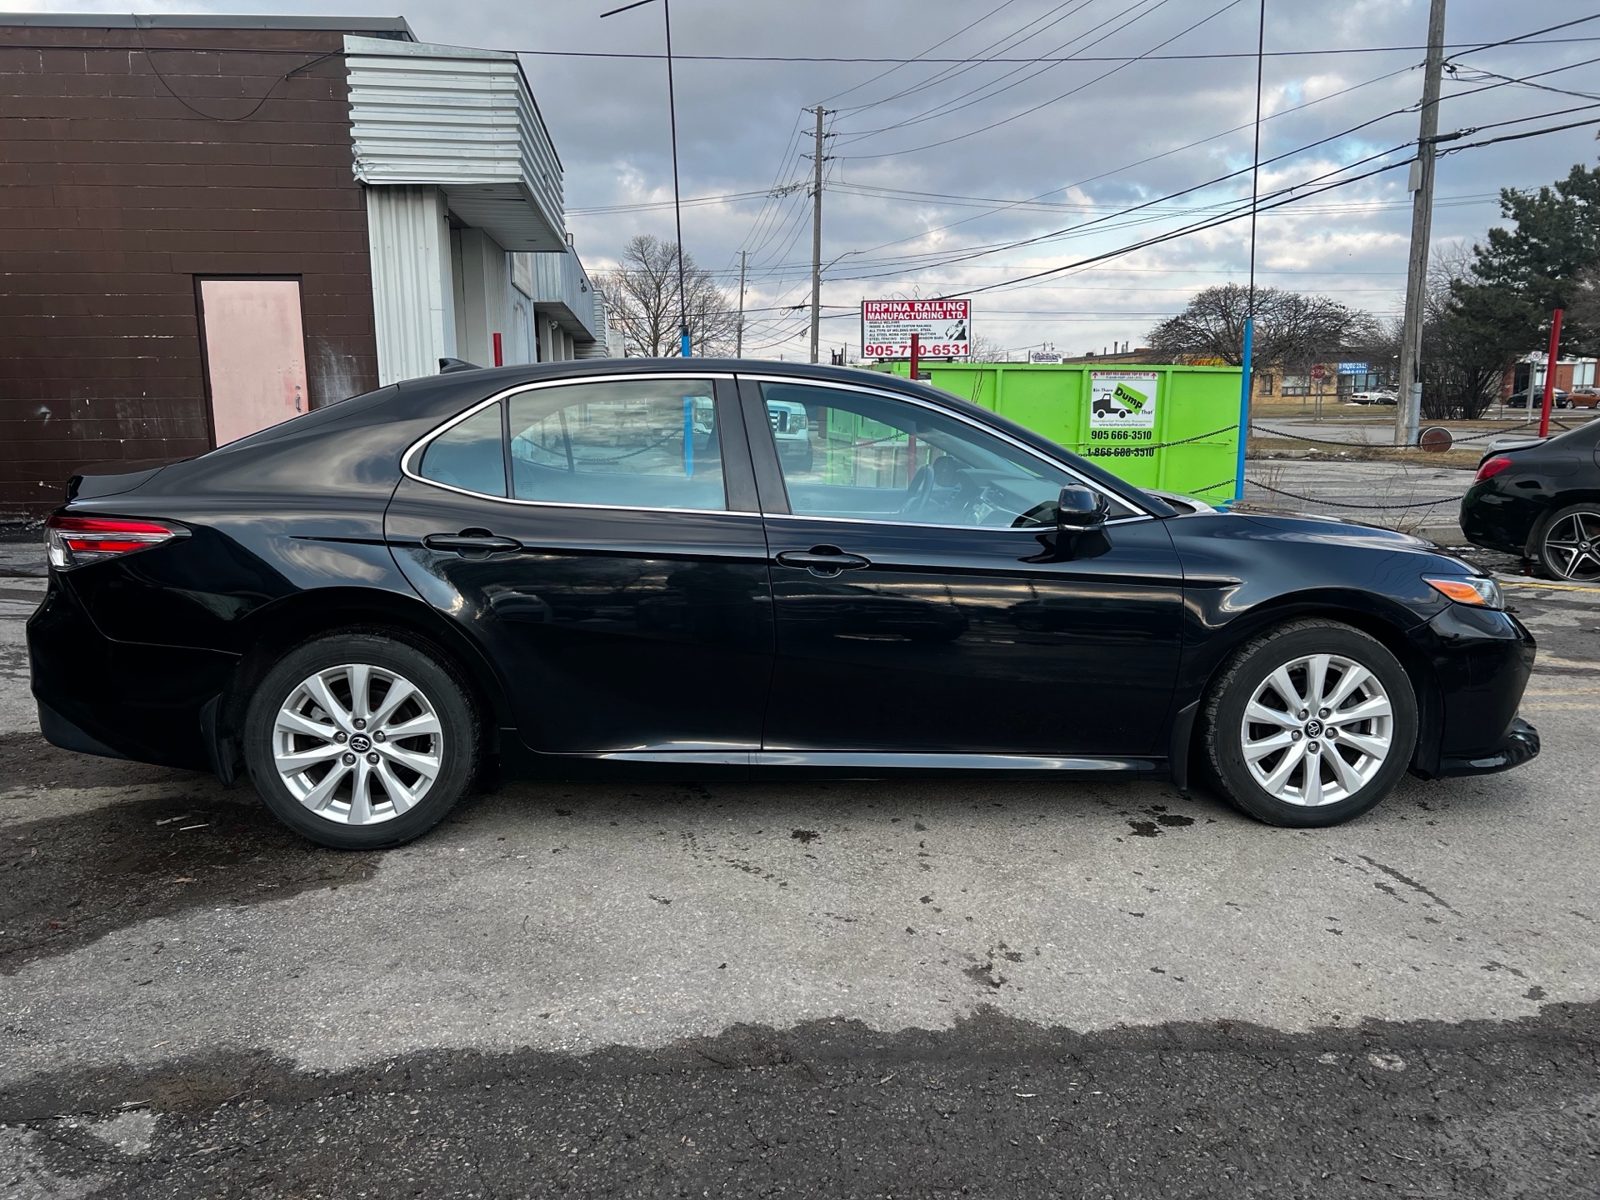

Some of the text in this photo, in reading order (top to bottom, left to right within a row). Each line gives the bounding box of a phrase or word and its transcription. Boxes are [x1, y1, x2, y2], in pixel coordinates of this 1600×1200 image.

[868, 302, 965, 312] IRPINA RAILING
[866, 344, 968, 356] 905-70-6531
[1114, 386, 1143, 409] Dump
[1091, 431, 1151, 440] 905 666-3510
